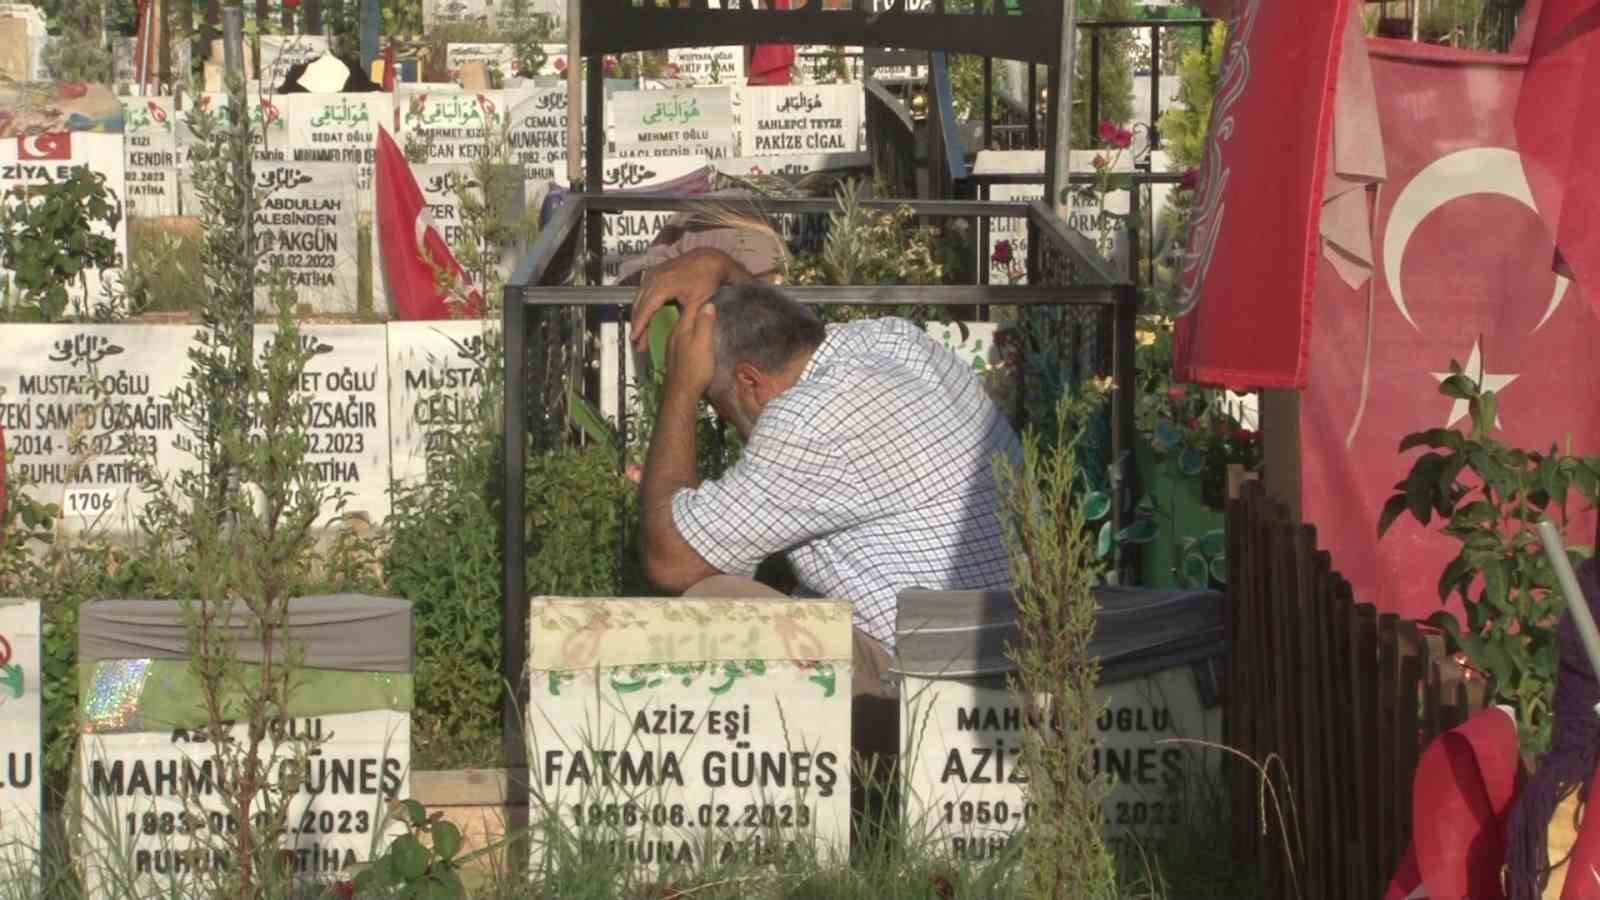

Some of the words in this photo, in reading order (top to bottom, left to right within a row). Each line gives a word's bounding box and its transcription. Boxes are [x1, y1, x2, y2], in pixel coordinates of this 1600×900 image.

[755, 133, 802, 150] PAKİZE
[130, 148, 173, 167] KENDİR
[264, 198, 341, 210] ABDULLAH
[1067, 211, 1121, 231] ÖRMEZ
[278, 228, 338, 252] AKGÜN
[103, 370, 150, 396] OĞLU
[326, 366, 376, 392] OĞLU
[405, 367, 485, 389] MUSTA
[13, 434, 51, 456] 2014
[68, 492, 113, 511] 1706
[634, 704, 695, 735] AZİZ
[707, 704, 751, 740] EŞİ
[545, 750, 684, 788] FATMA
[702, 741, 838, 798] GÜNEŞ
